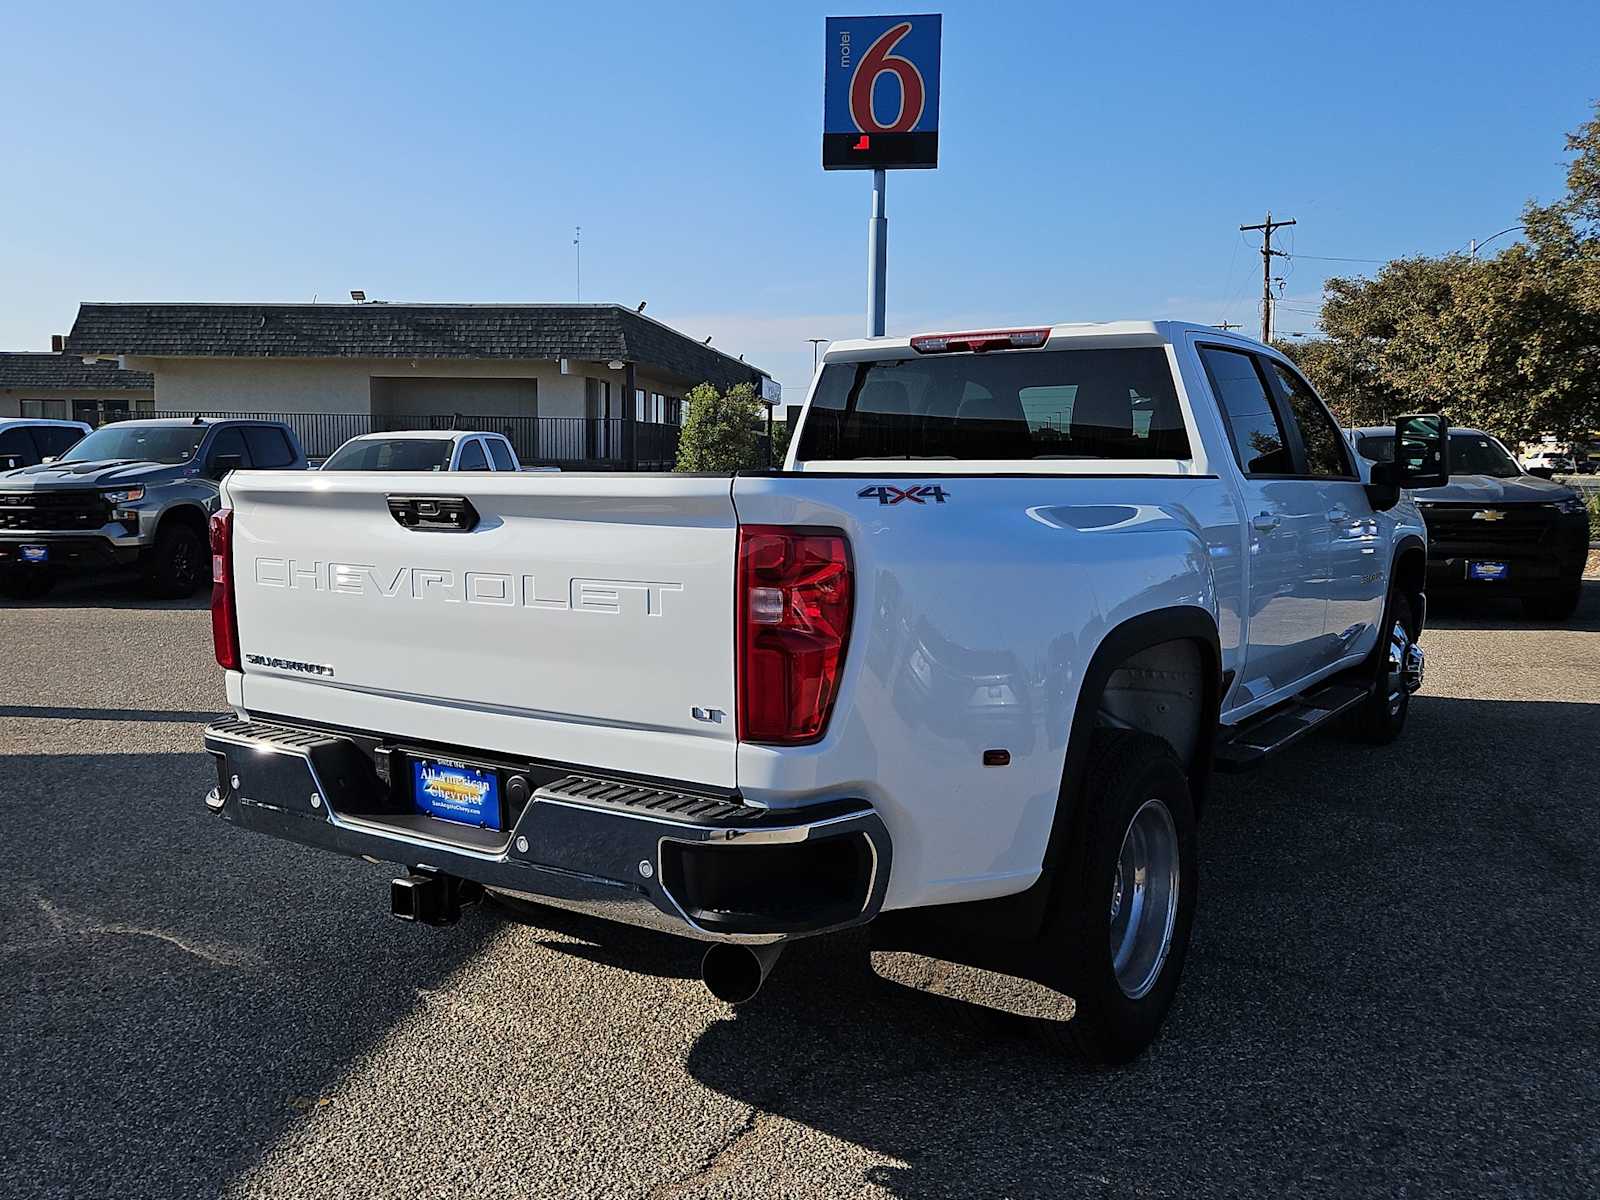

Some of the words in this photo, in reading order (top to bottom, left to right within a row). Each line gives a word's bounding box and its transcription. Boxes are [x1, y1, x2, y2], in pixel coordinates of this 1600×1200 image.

[840, 31, 850, 68] motel
[849, 22, 925, 132] 6
[254, 556, 684, 616] CHEVROLET
[245, 653, 335, 677] SILVERADO
[691, 706, 727, 724] LT
[420, 768, 435, 780] All
[438, 771, 490, 791] American
[430, 783, 483, 805] Chevrolet
